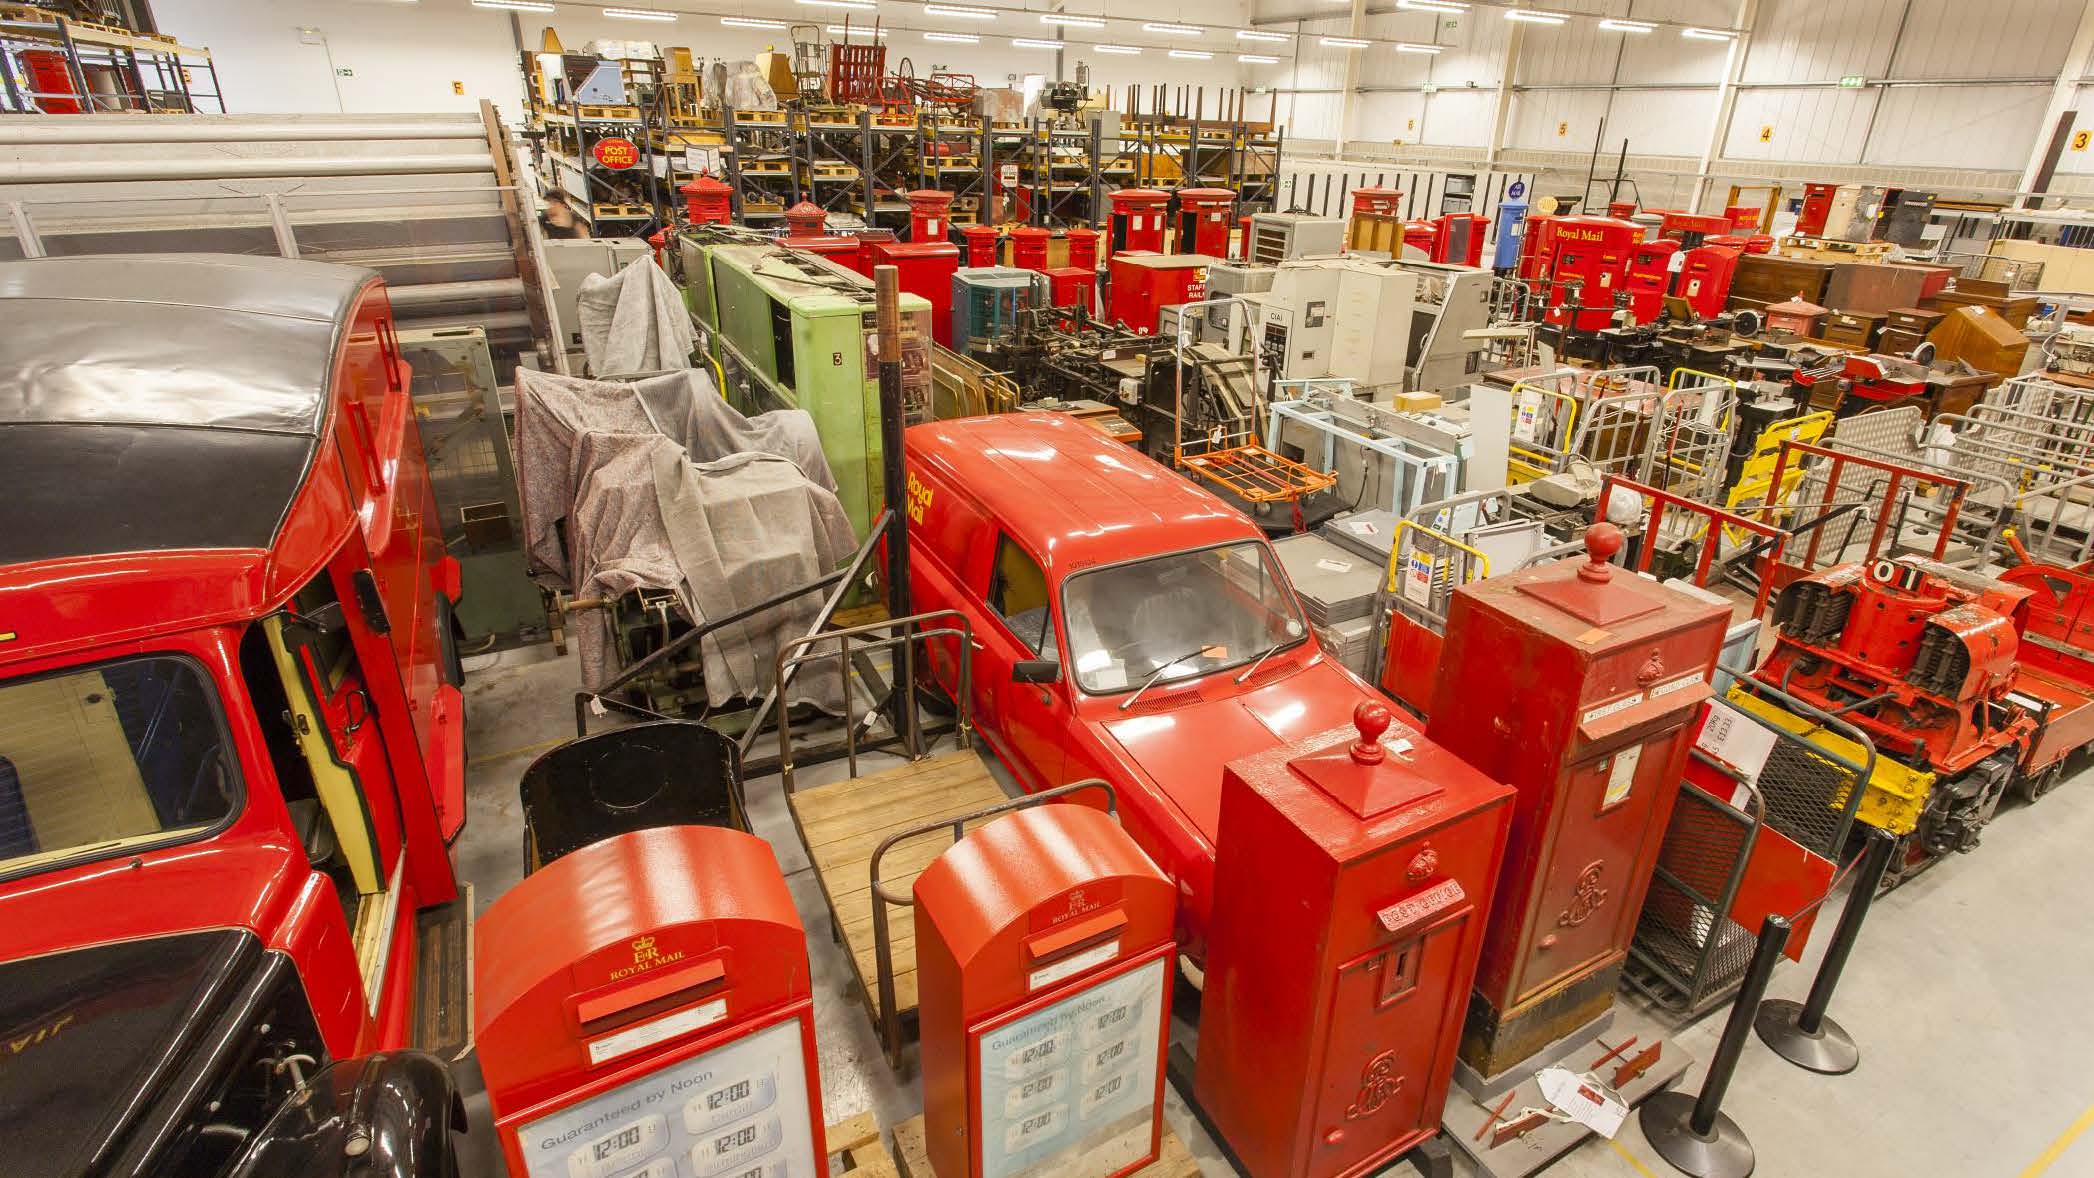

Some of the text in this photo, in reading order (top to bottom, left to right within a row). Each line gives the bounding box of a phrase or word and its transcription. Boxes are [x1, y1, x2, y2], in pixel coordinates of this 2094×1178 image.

[604, 146, 628, 155] POST
[2076, 133, 2087, 148] 3
[602, 156, 633, 164] OFFICE
[1556, 226, 1604, 241] Royal Mail
[834, 353, 842, 366] 3
[908, 471, 934, 508] Royal
[907, 493, 924, 526] Mail
[610, 950, 685, 981] ROYAL MAIL
[706, 1079, 750, 1111] 12:00
[541, 1070, 713, 1151] Guaranteed by Noon
[592, 1125, 641, 1161] 12:00
[714, 1125, 756, 1155] 12:00
